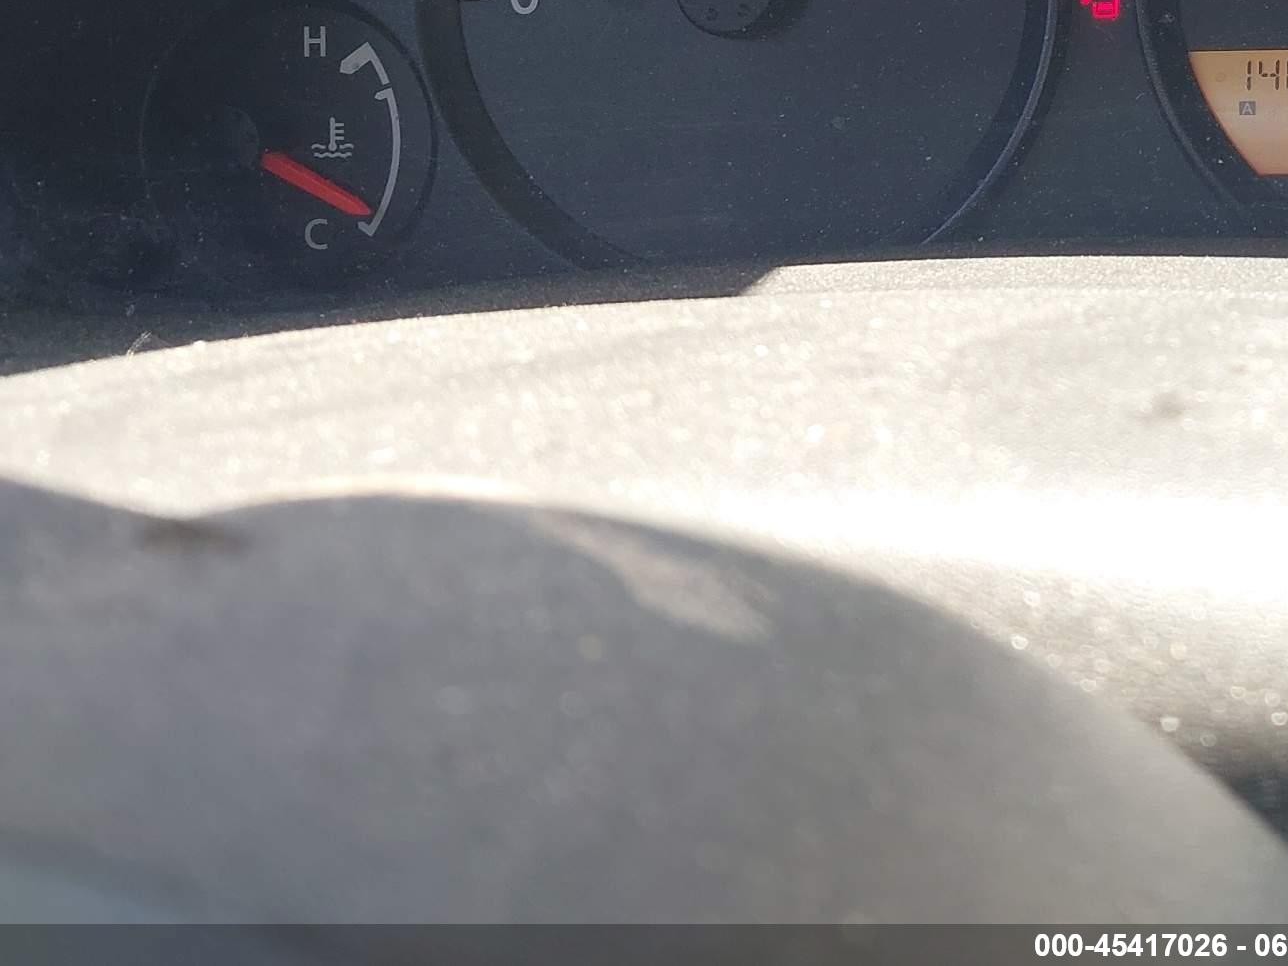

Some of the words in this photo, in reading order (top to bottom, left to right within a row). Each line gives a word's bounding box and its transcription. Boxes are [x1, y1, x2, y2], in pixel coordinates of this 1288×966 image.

[303, 25, 327, 58] H
[1240, 101, 1256, 115] A
[304, 218, 329, 251] C
